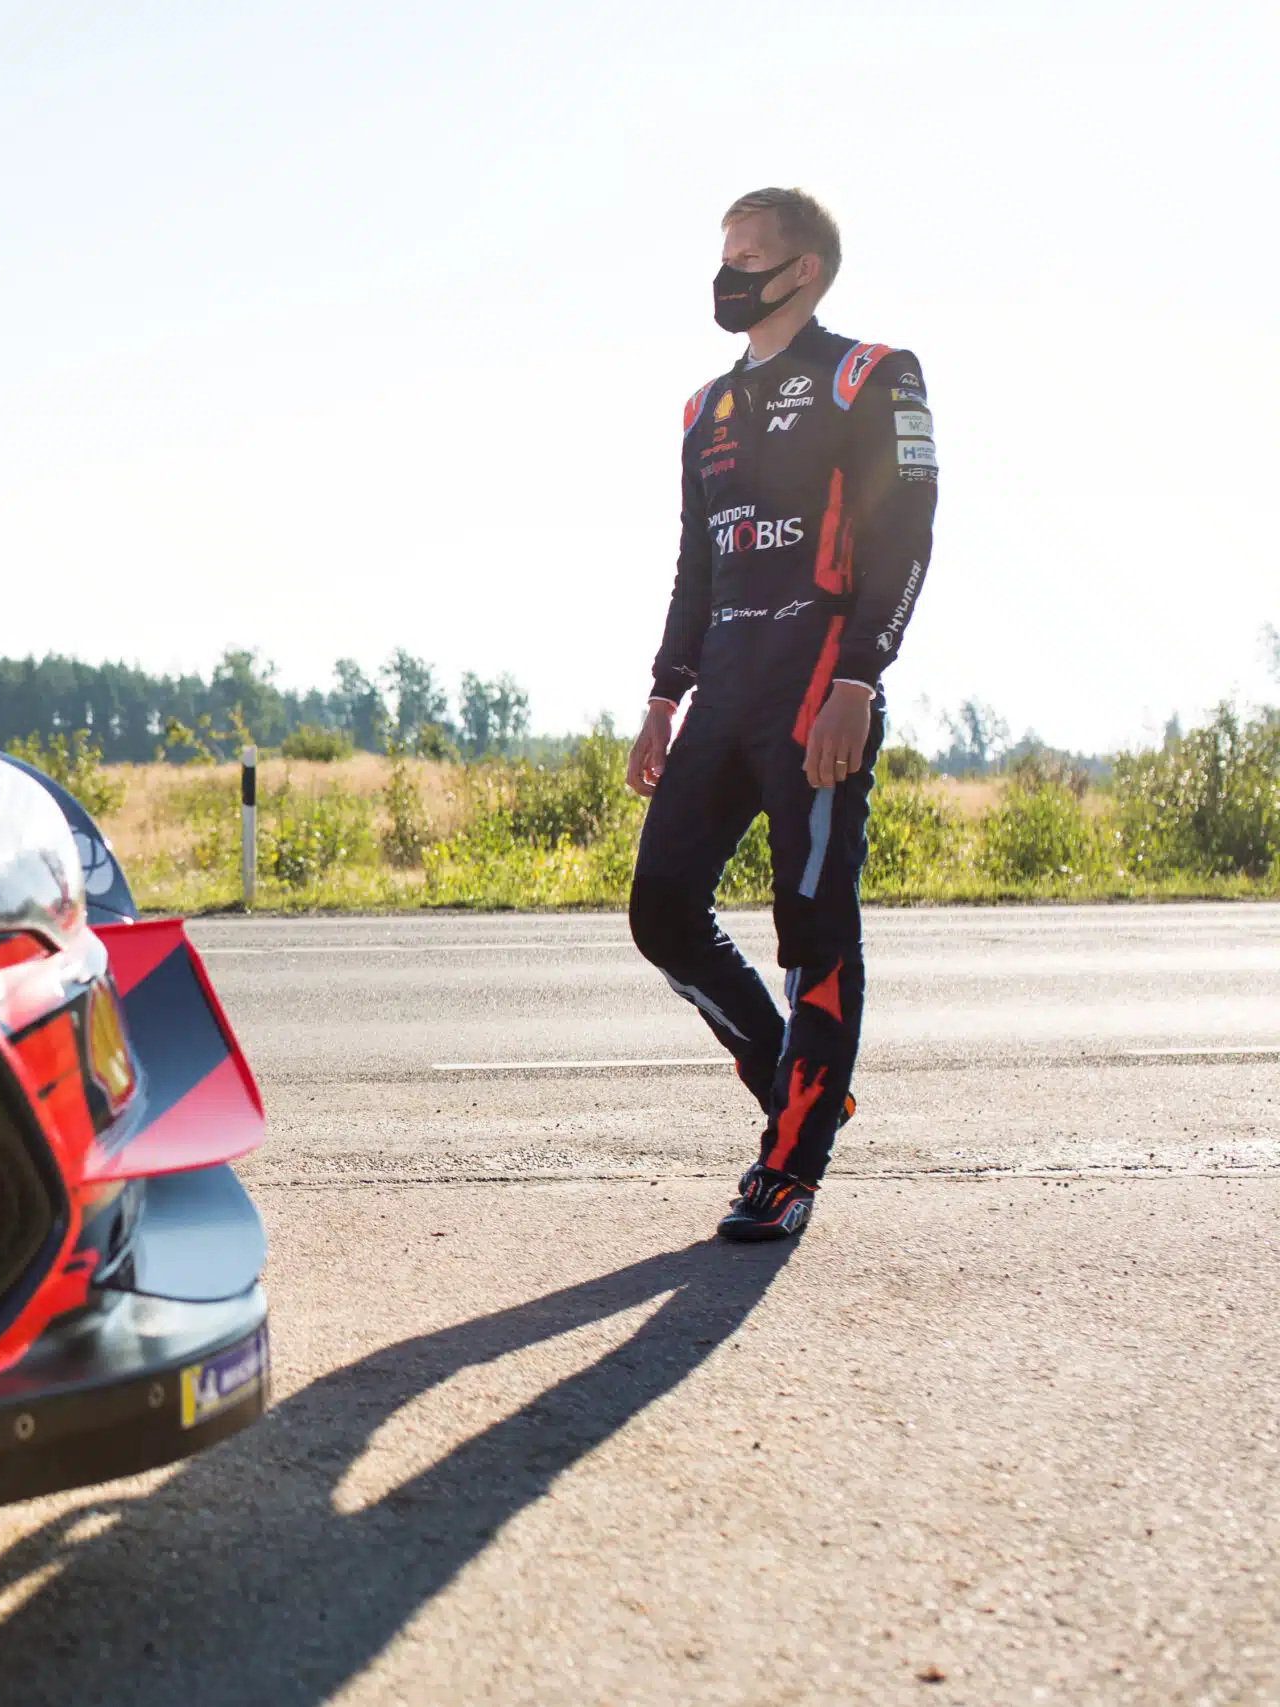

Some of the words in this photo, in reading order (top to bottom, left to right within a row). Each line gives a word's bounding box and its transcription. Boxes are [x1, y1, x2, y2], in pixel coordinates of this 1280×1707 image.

[766, 396, 815, 411] HYUNDAI
[715, 517, 804, 556] MOBIS
[887, 560, 922, 632] HYUNDAI
